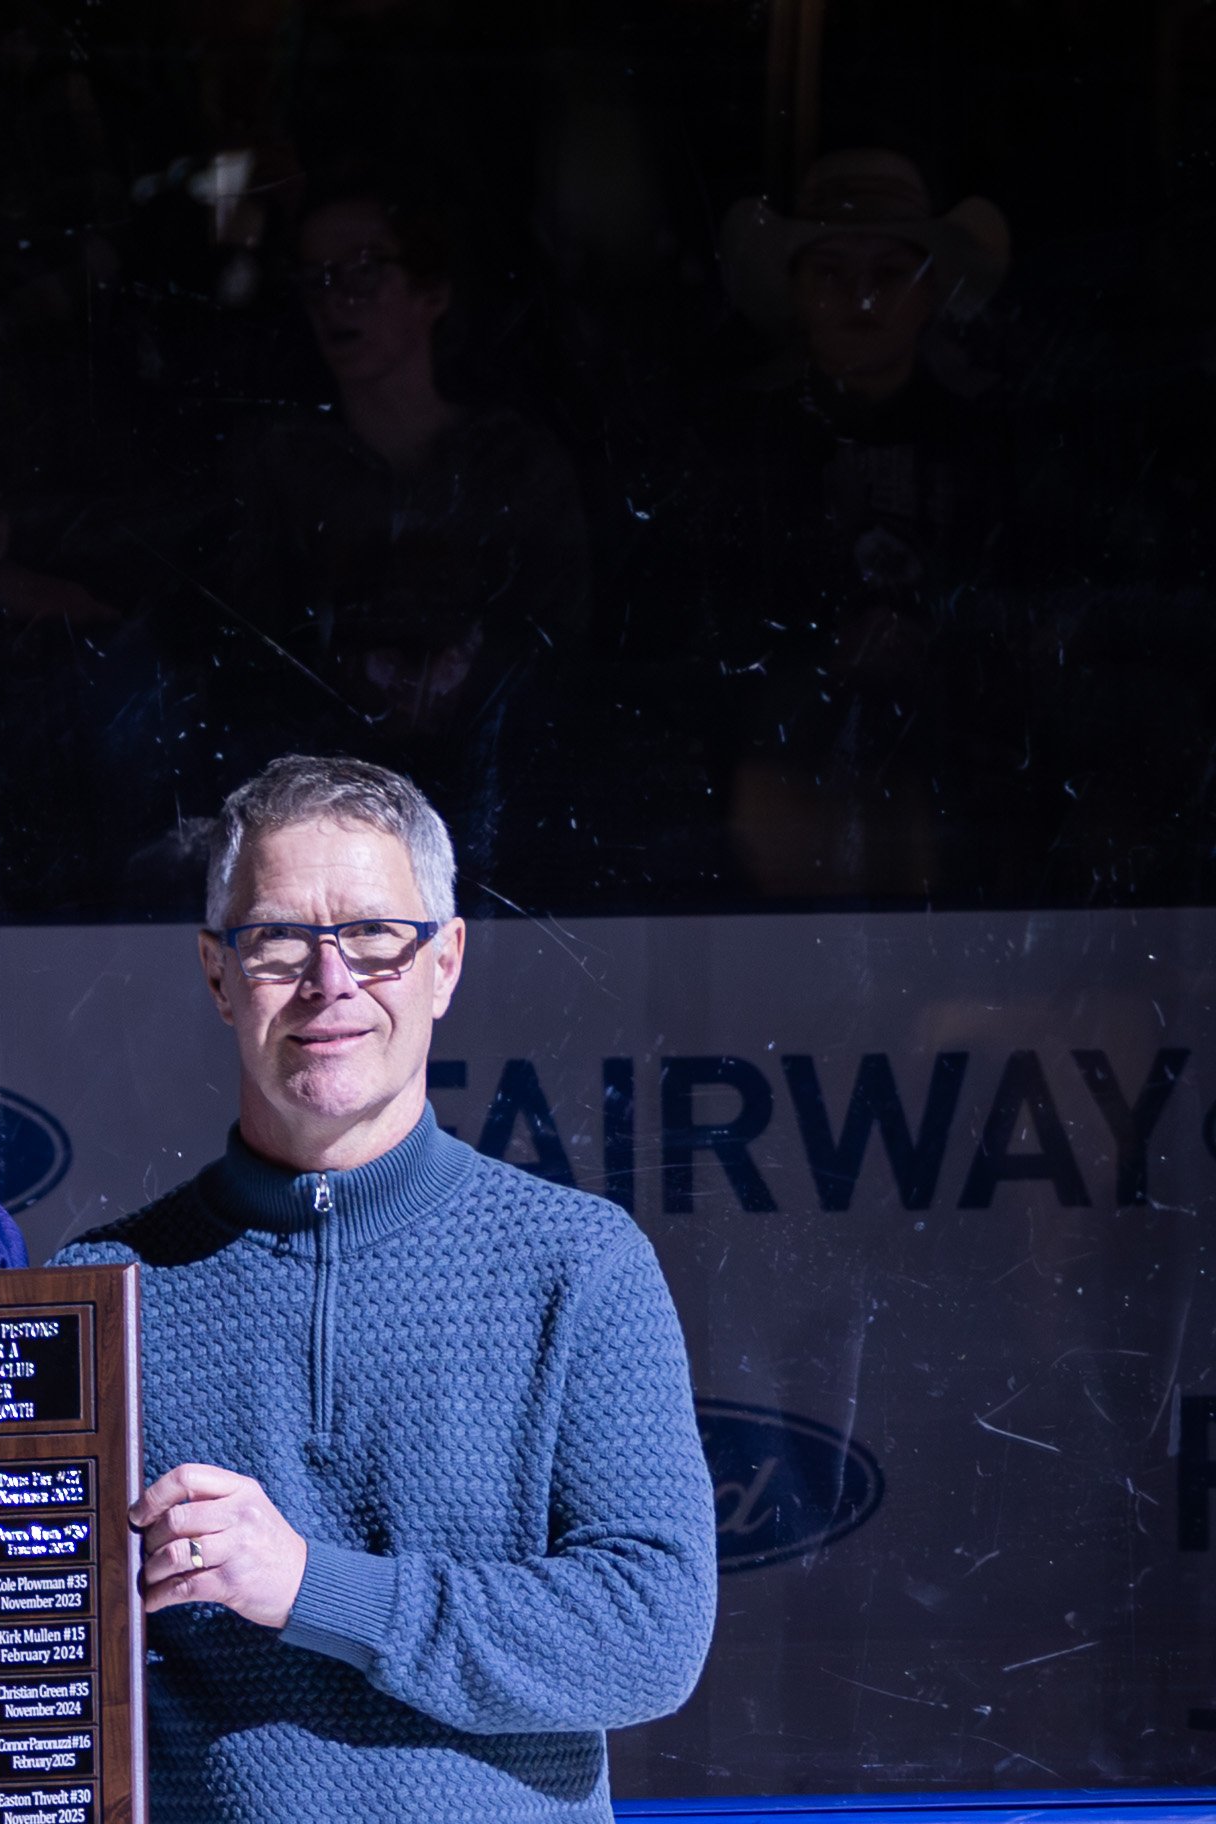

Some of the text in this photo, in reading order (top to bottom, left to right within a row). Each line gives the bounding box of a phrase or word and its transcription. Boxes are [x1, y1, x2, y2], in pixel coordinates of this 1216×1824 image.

[1, 1322, 58, 1337] PISTONS
[10, 1344, 19, 1359] A
[0, 1362, 34, 1378] CLUB
[15, 1576, 64, 1592] Plowman
[67, 1574, 87, 1588] #35
[1, 1594, 81, 1609] November 2023
[23, 1628, 61, 1643] Mullen
[64, 1627, 85, 1641] #15
[1, 1645, 84, 1663] February 2024
[39, 1684, 68, 1698] Green
[69, 1682, 89, 1696] #35
[5, 1701, 81, 1718] November 2024
[29, 1736, 72, 1751] Paronuzzi
[72, 1735, 91, 1749] #16
[12, 1753, 76, 1770] February 2025
[32, 1791, 68, 1805] Thvedt
[70, 1790, 91, 1804] #30
[58, 1808, 85, 1823] 2025
